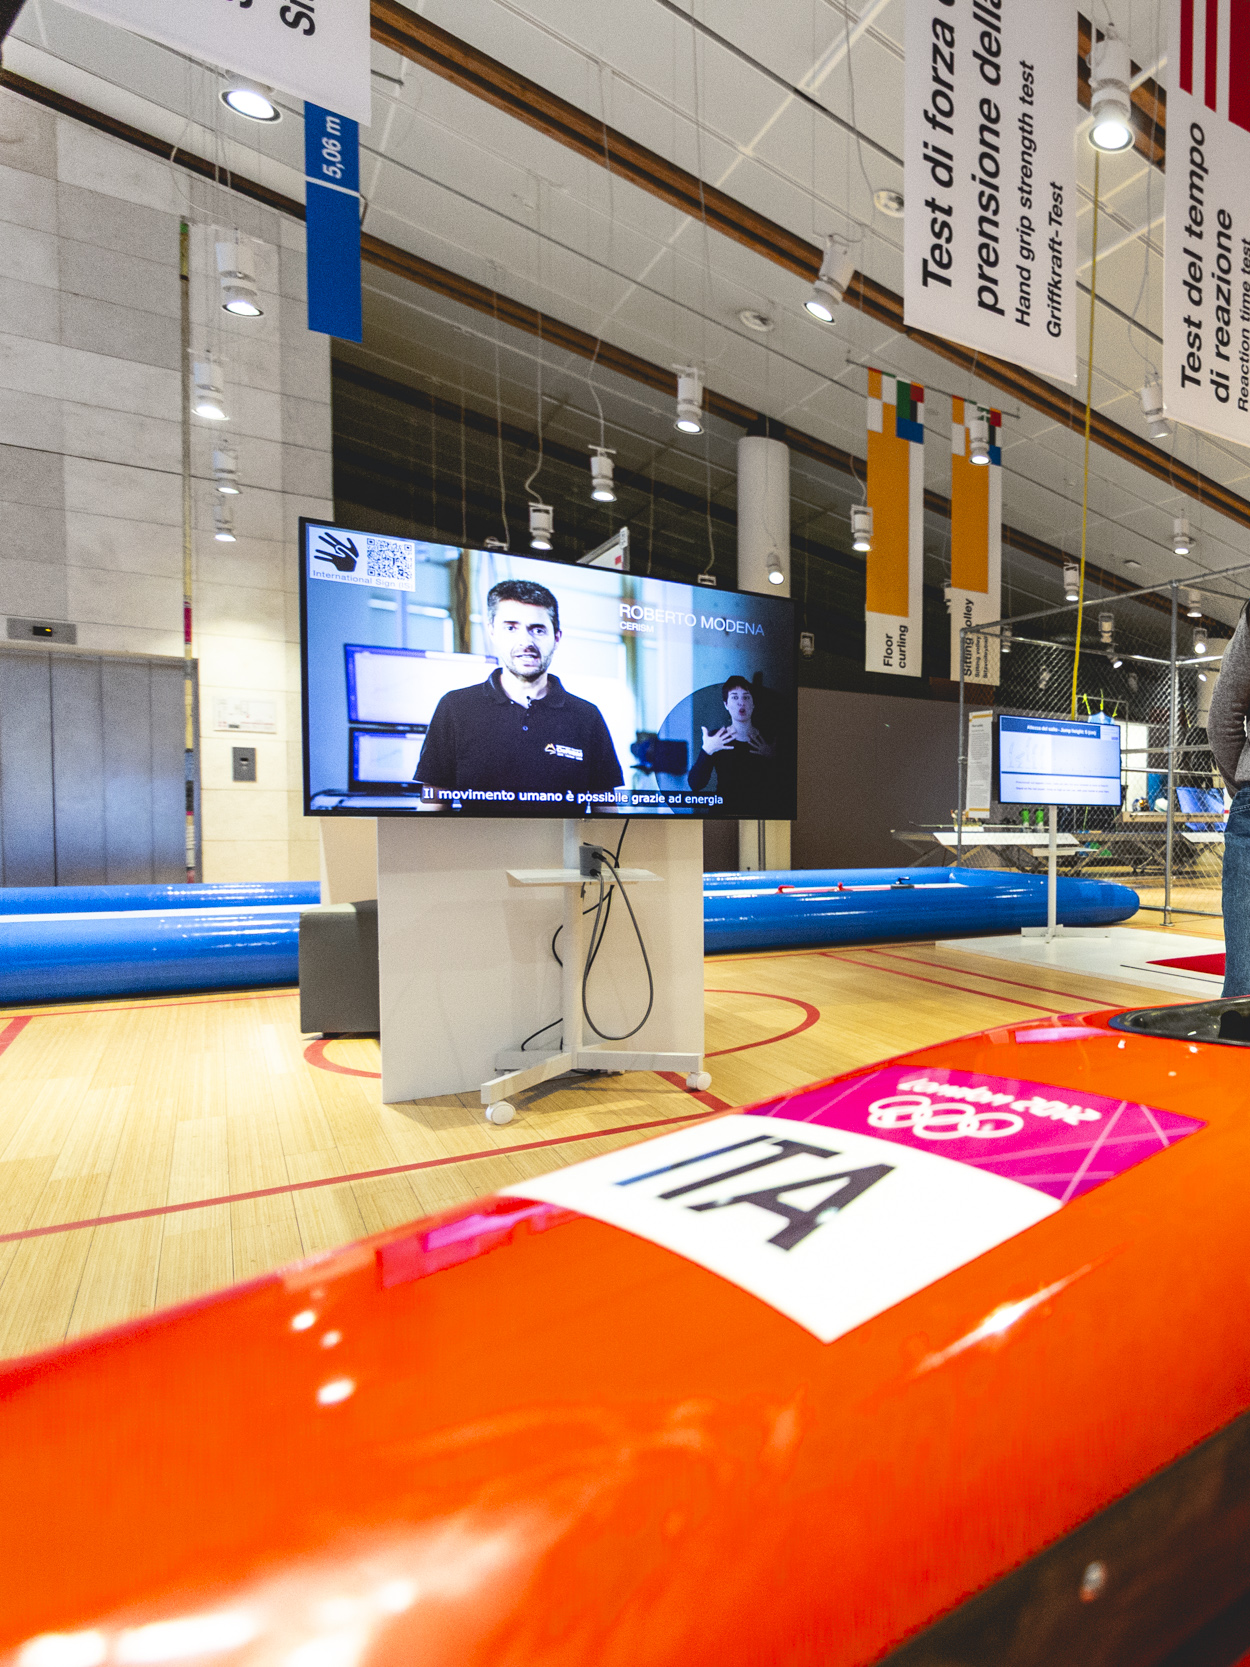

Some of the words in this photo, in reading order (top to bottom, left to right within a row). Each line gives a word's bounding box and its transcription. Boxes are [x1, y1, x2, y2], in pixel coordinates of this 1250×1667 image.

[279, 0, 316, 36] Si
[923, 17, 956, 136] forza
[1018, 59, 1035, 108] test
[325, 116, 341, 137] m
[321, 137, 345, 180] 5,06
[923, 140, 955, 189] di
[1017, 111, 1037, 211] strength
[1184, 122, 1209, 240] tempo
[971, 97, 1005, 317] prensione
[922, 197, 954, 288] Test
[1016, 215, 1036, 263] grip
[1046, 181, 1064, 339] Griffkraft-Test
[1015, 264, 1032, 328] Hand
[1182, 247, 1204, 307] del
[1211, 208, 1233, 363] reazione
[1181, 315, 1202, 389] Test
[1238, 325, 1250, 412] Reaction
[1210, 371, 1231, 404] di
[312, 569, 373, 585] International
[619, 603, 697, 627] ROBERTO
[701, 615, 765, 637] MODENA
[619, 620, 655, 633] CERISM
[963, 598, 975, 629] olley
[883, 633, 894, 667] Floor
[896, 624, 909, 669] curling
[423, 787, 434, 800] Il
[438, 788, 516, 802] movimento
[518, 791, 563, 802] umano
[566, 790, 575, 802] è
[577, 790, 628, 804] possibile
[631, 792, 665, 806] grazie
[668, 792, 682, 804] ad
[684, 793, 724, 807] energia
[612, 1134, 896, 1251] ITA
